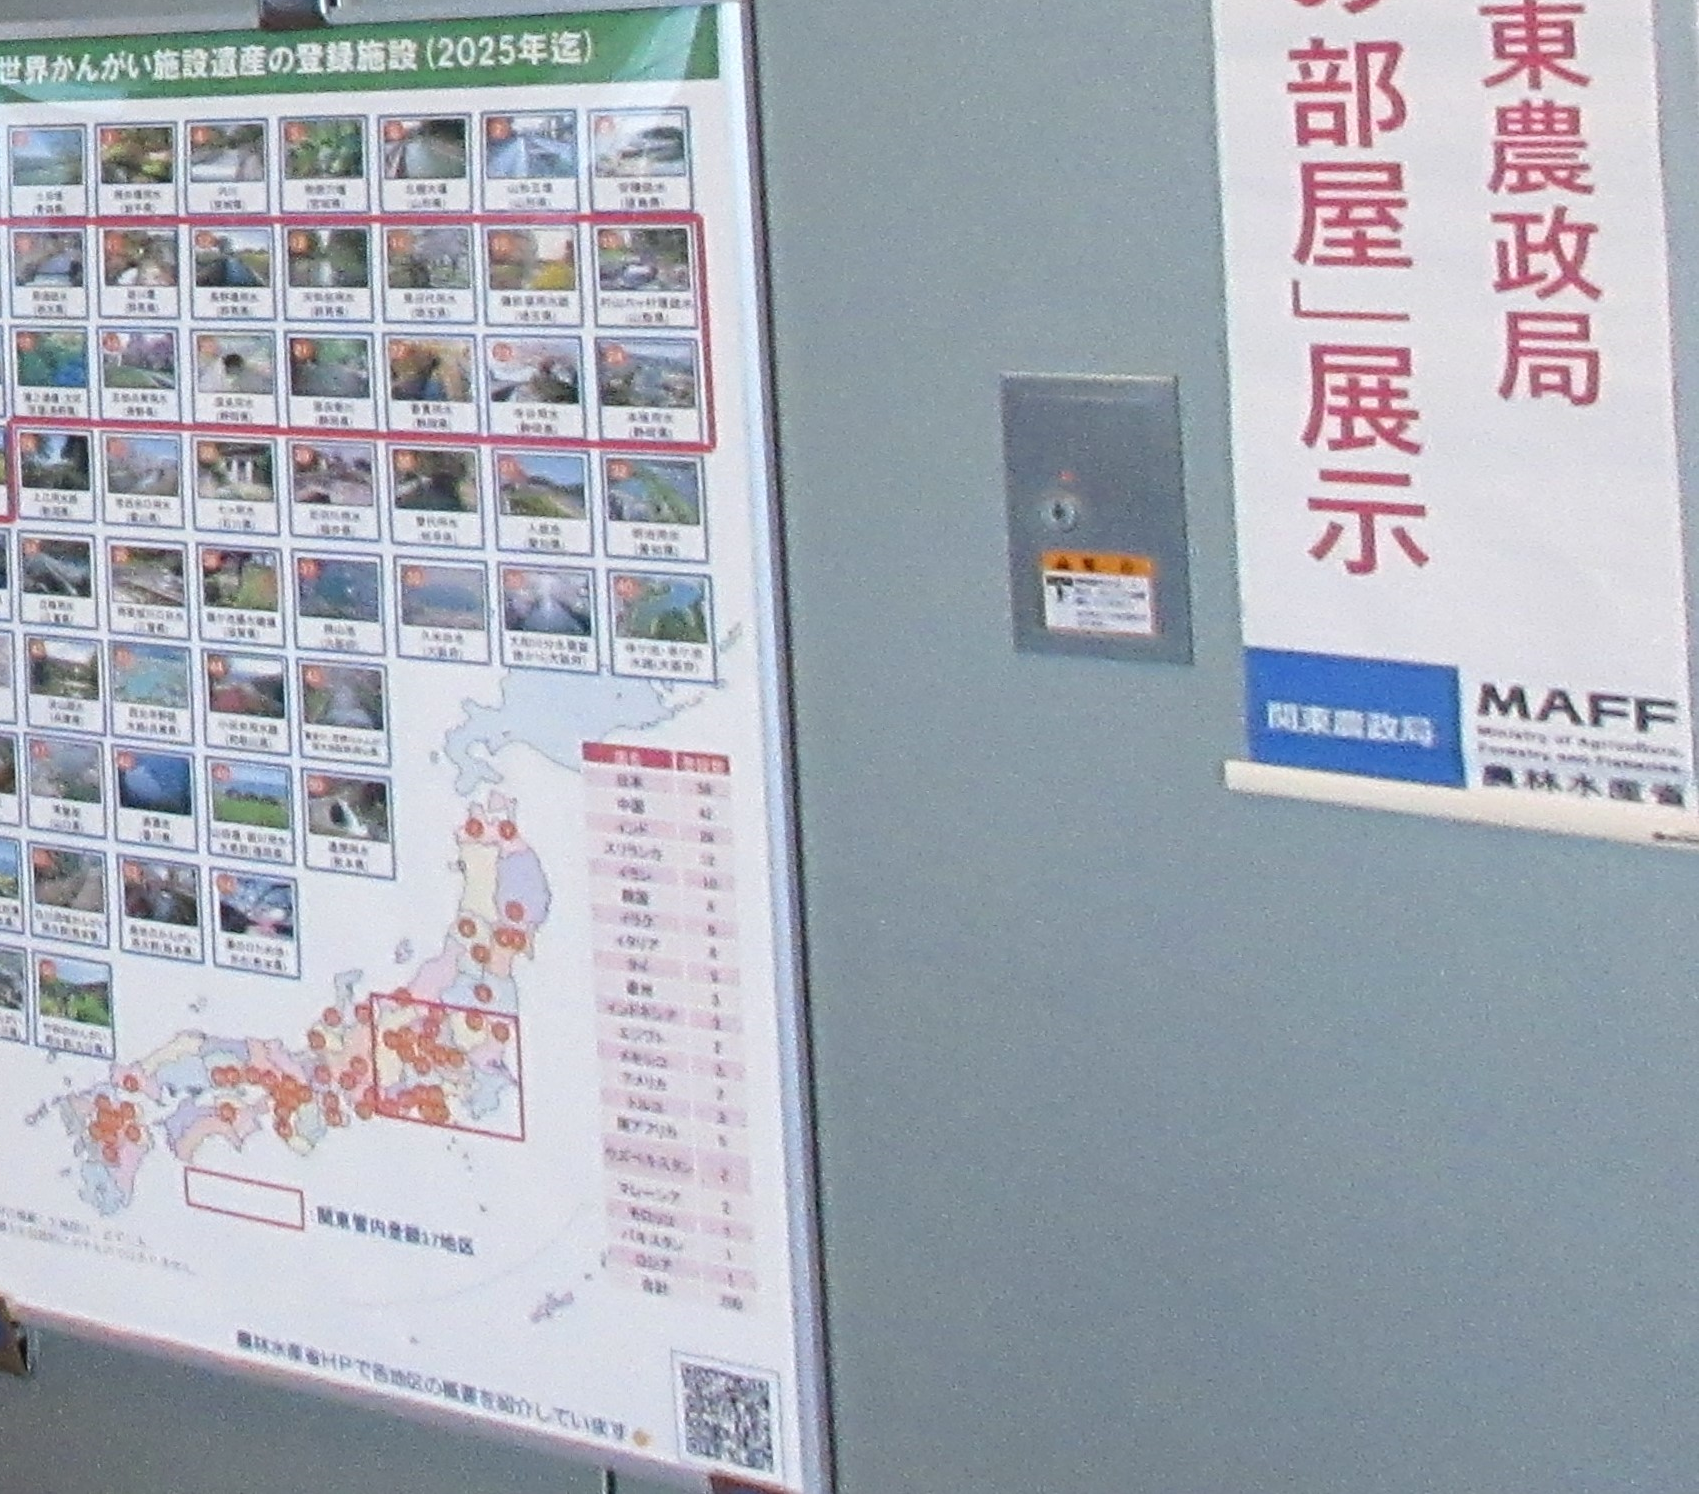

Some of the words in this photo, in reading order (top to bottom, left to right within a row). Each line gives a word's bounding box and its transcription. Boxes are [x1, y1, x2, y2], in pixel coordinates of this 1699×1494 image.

[1477, 682, 1679, 733] MAFF
[1482, 762, 1687, 808] 農林水産省
